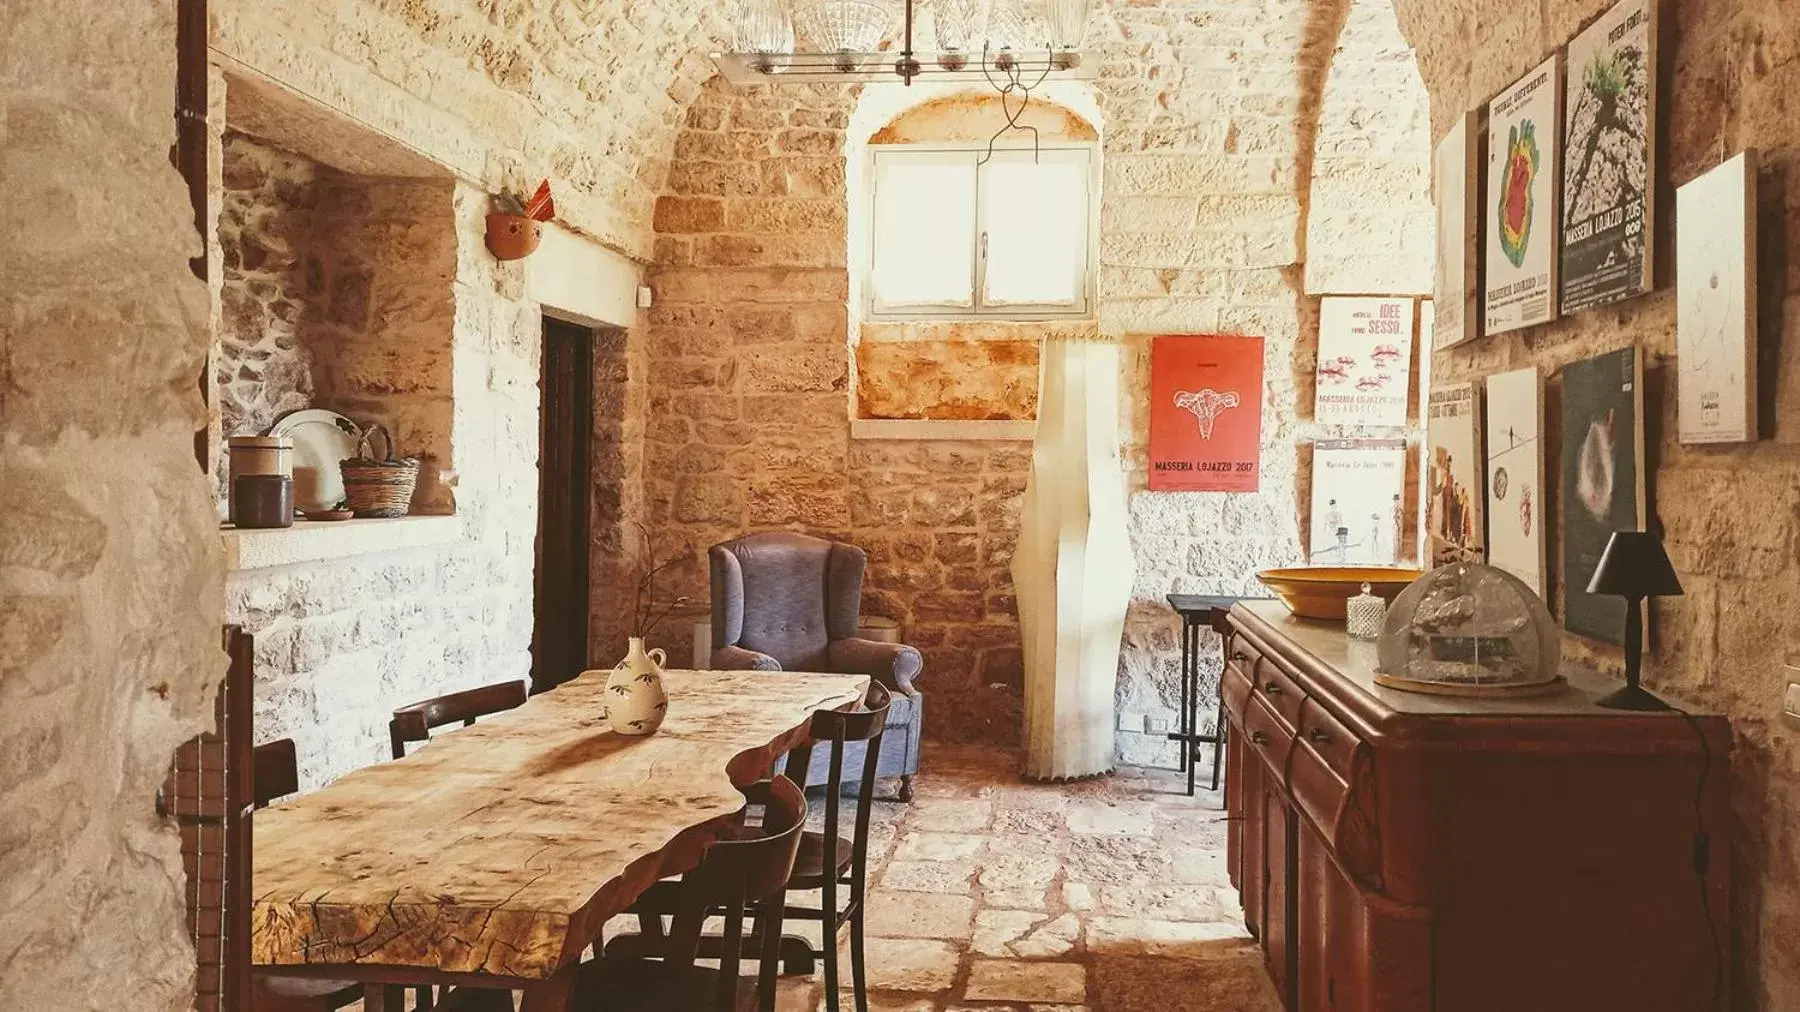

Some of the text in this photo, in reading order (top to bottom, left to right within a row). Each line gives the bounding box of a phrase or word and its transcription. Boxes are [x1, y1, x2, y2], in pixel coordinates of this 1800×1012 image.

[1565, 220, 1593, 247] MASSERIA
[1595, 206, 1623, 234] LOJAZZO
[1625, 199, 1641, 220] 2015
[1380, 304, 1400, 319] IDEE
[1368, 320, 1400, 335] SESSO
[1154, 462, 1254, 472] MASSERIA LOJAZZO 2017
